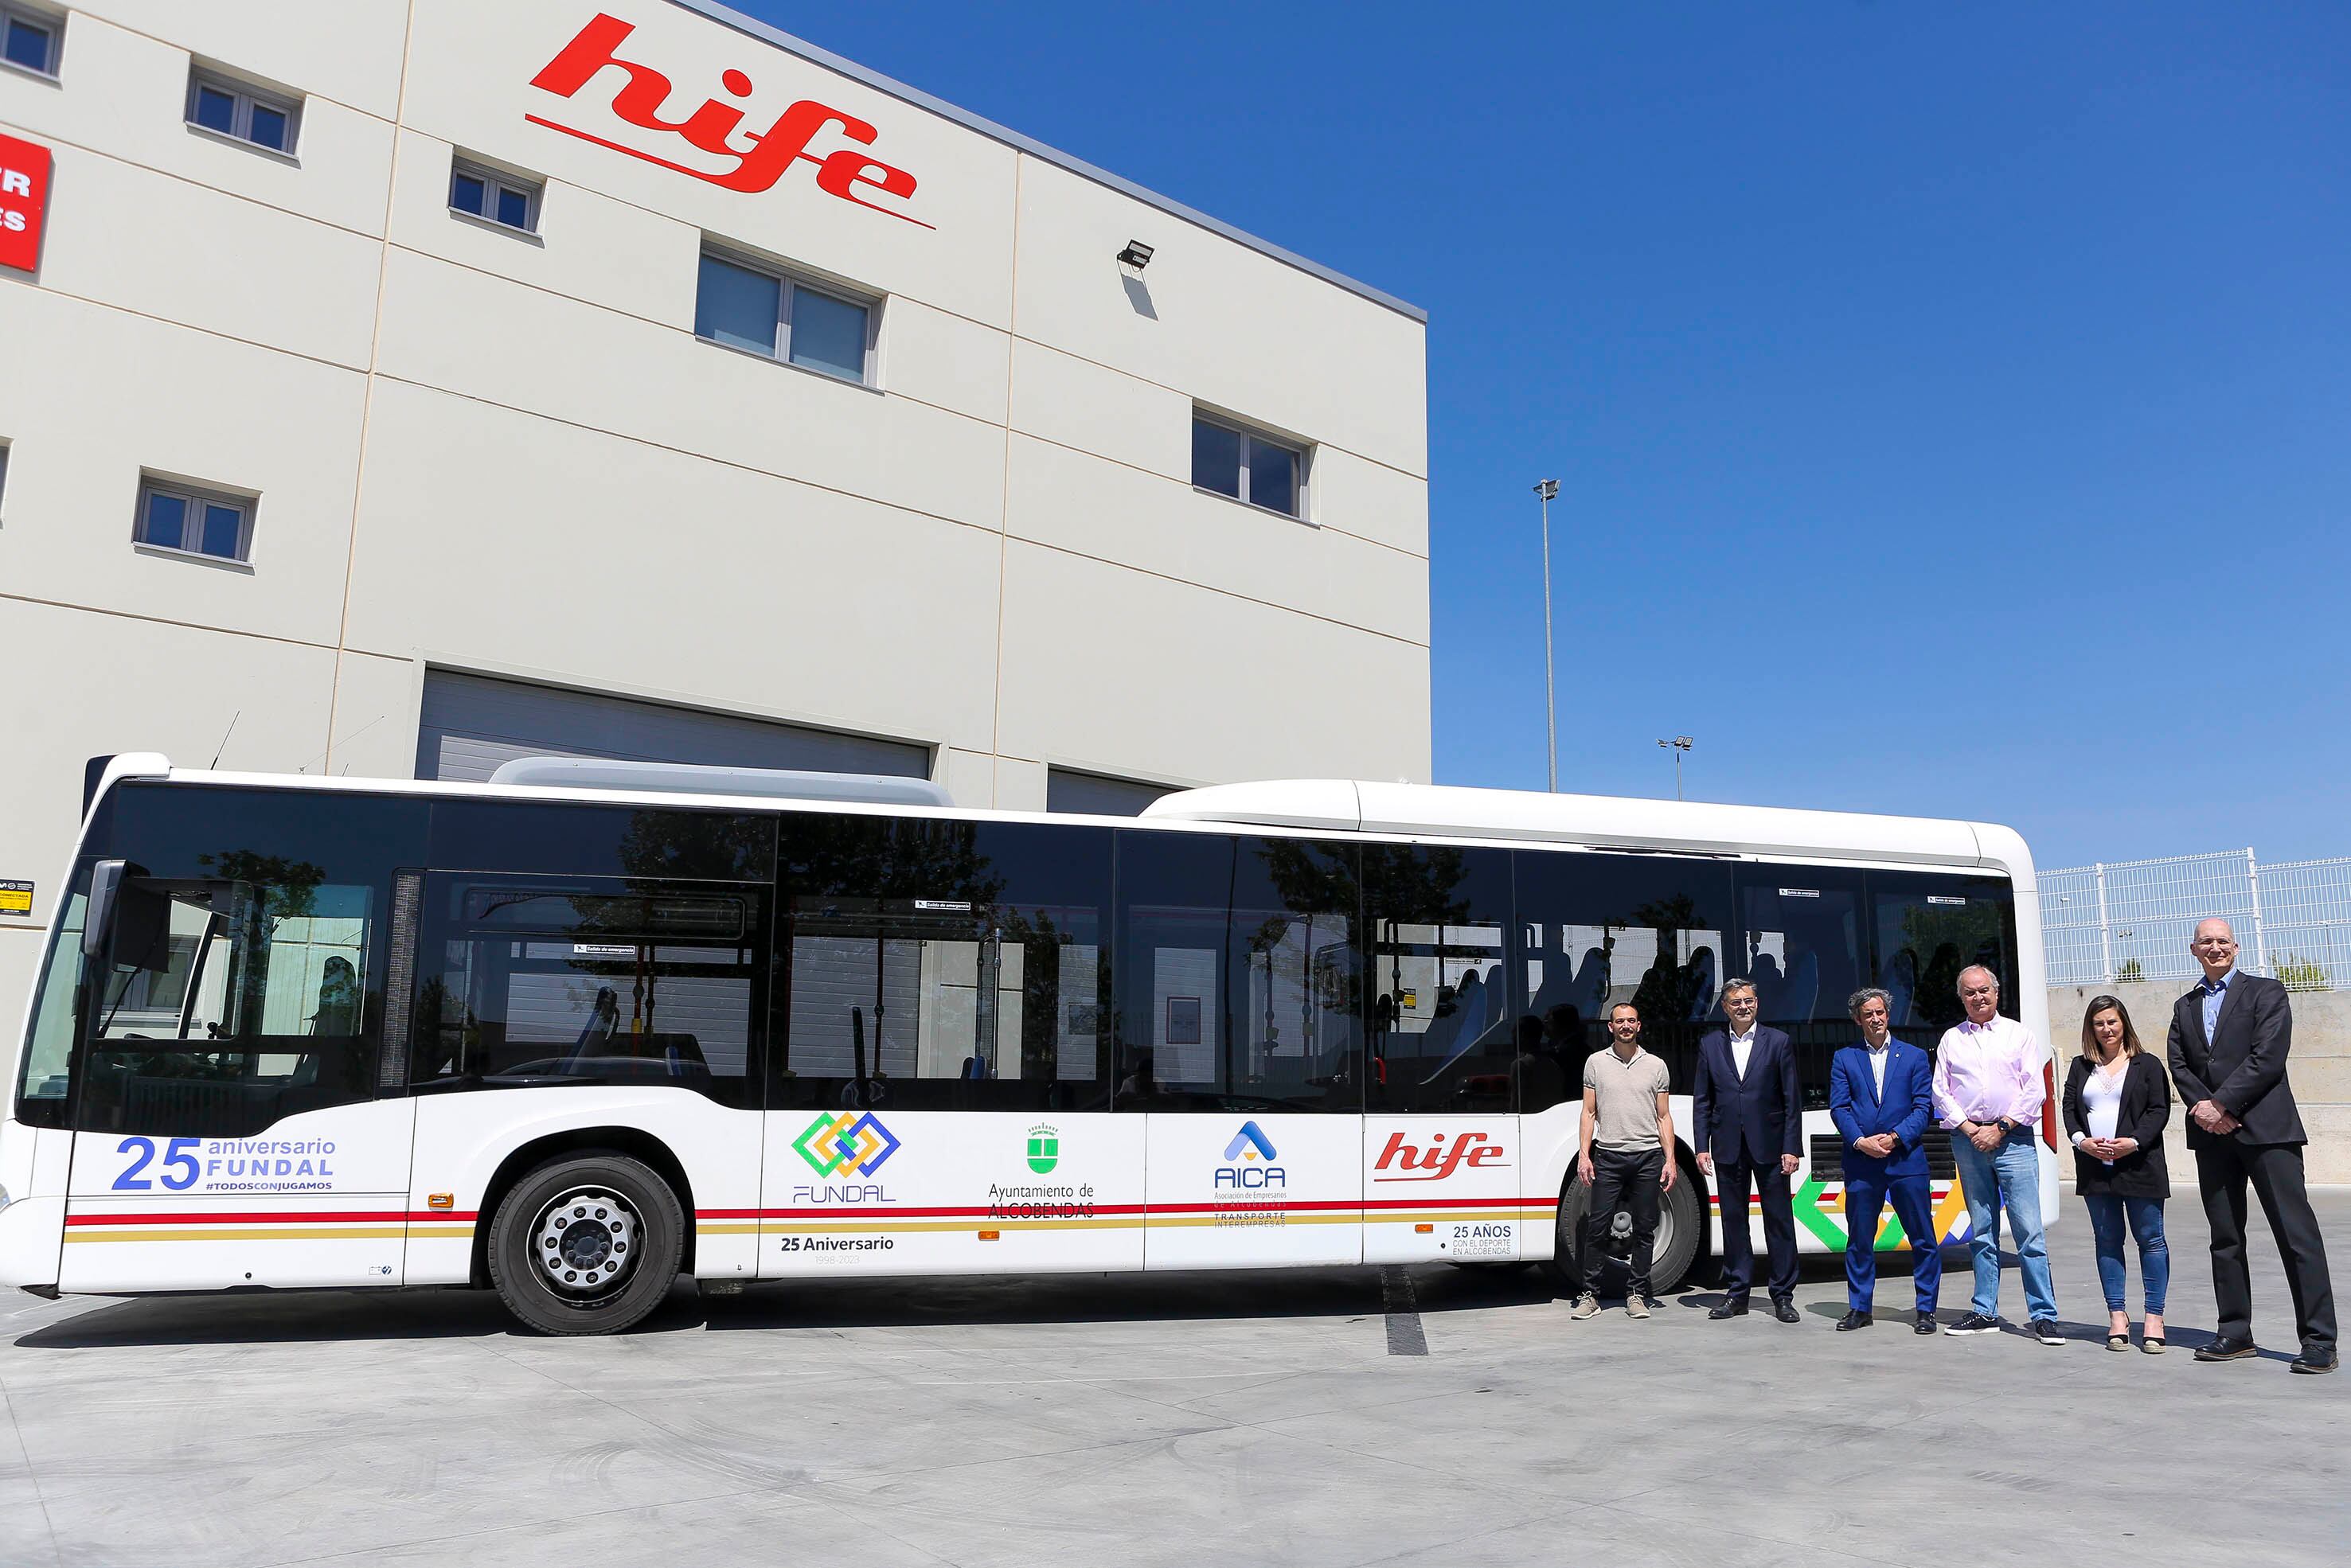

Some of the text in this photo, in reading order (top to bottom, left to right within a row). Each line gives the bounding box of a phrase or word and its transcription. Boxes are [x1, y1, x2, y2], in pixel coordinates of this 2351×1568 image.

[525, 13, 936, 230] hife
[0, 167, 31, 198] R
[0, 207, 26, 232] S
[111, 1137, 336, 1191] 25 aniversario
[1374, 1133, 1511, 1182] hife
[206, 1159, 333, 1176] FUNDAL
[205, 1182, 332, 1191] #TODOSCONJUGAMOS
[1214, 1168, 1286, 1188] AICA
[793, 1185, 896, 1203] FUNDAL
[988, 1183, 1094, 1202] Ayuntamiento de
[1214, 1192, 1244, 1200] Asociación
[1253, 1191, 1287, 1200] Empresarios
[988, 1202, 1094, 1219] ALCOBENDAS
[1214, 1212, 1286, 1221] TRANSPORTE
[1214, 1219, 1287, 1229] INTEREMPRESAS
[1453, 1223, 1511, 1238] 25 AÑOS
[781, 1236, 894, 1251] 25 Aniversario
[1452, 1239, 1468, 1248] CON
